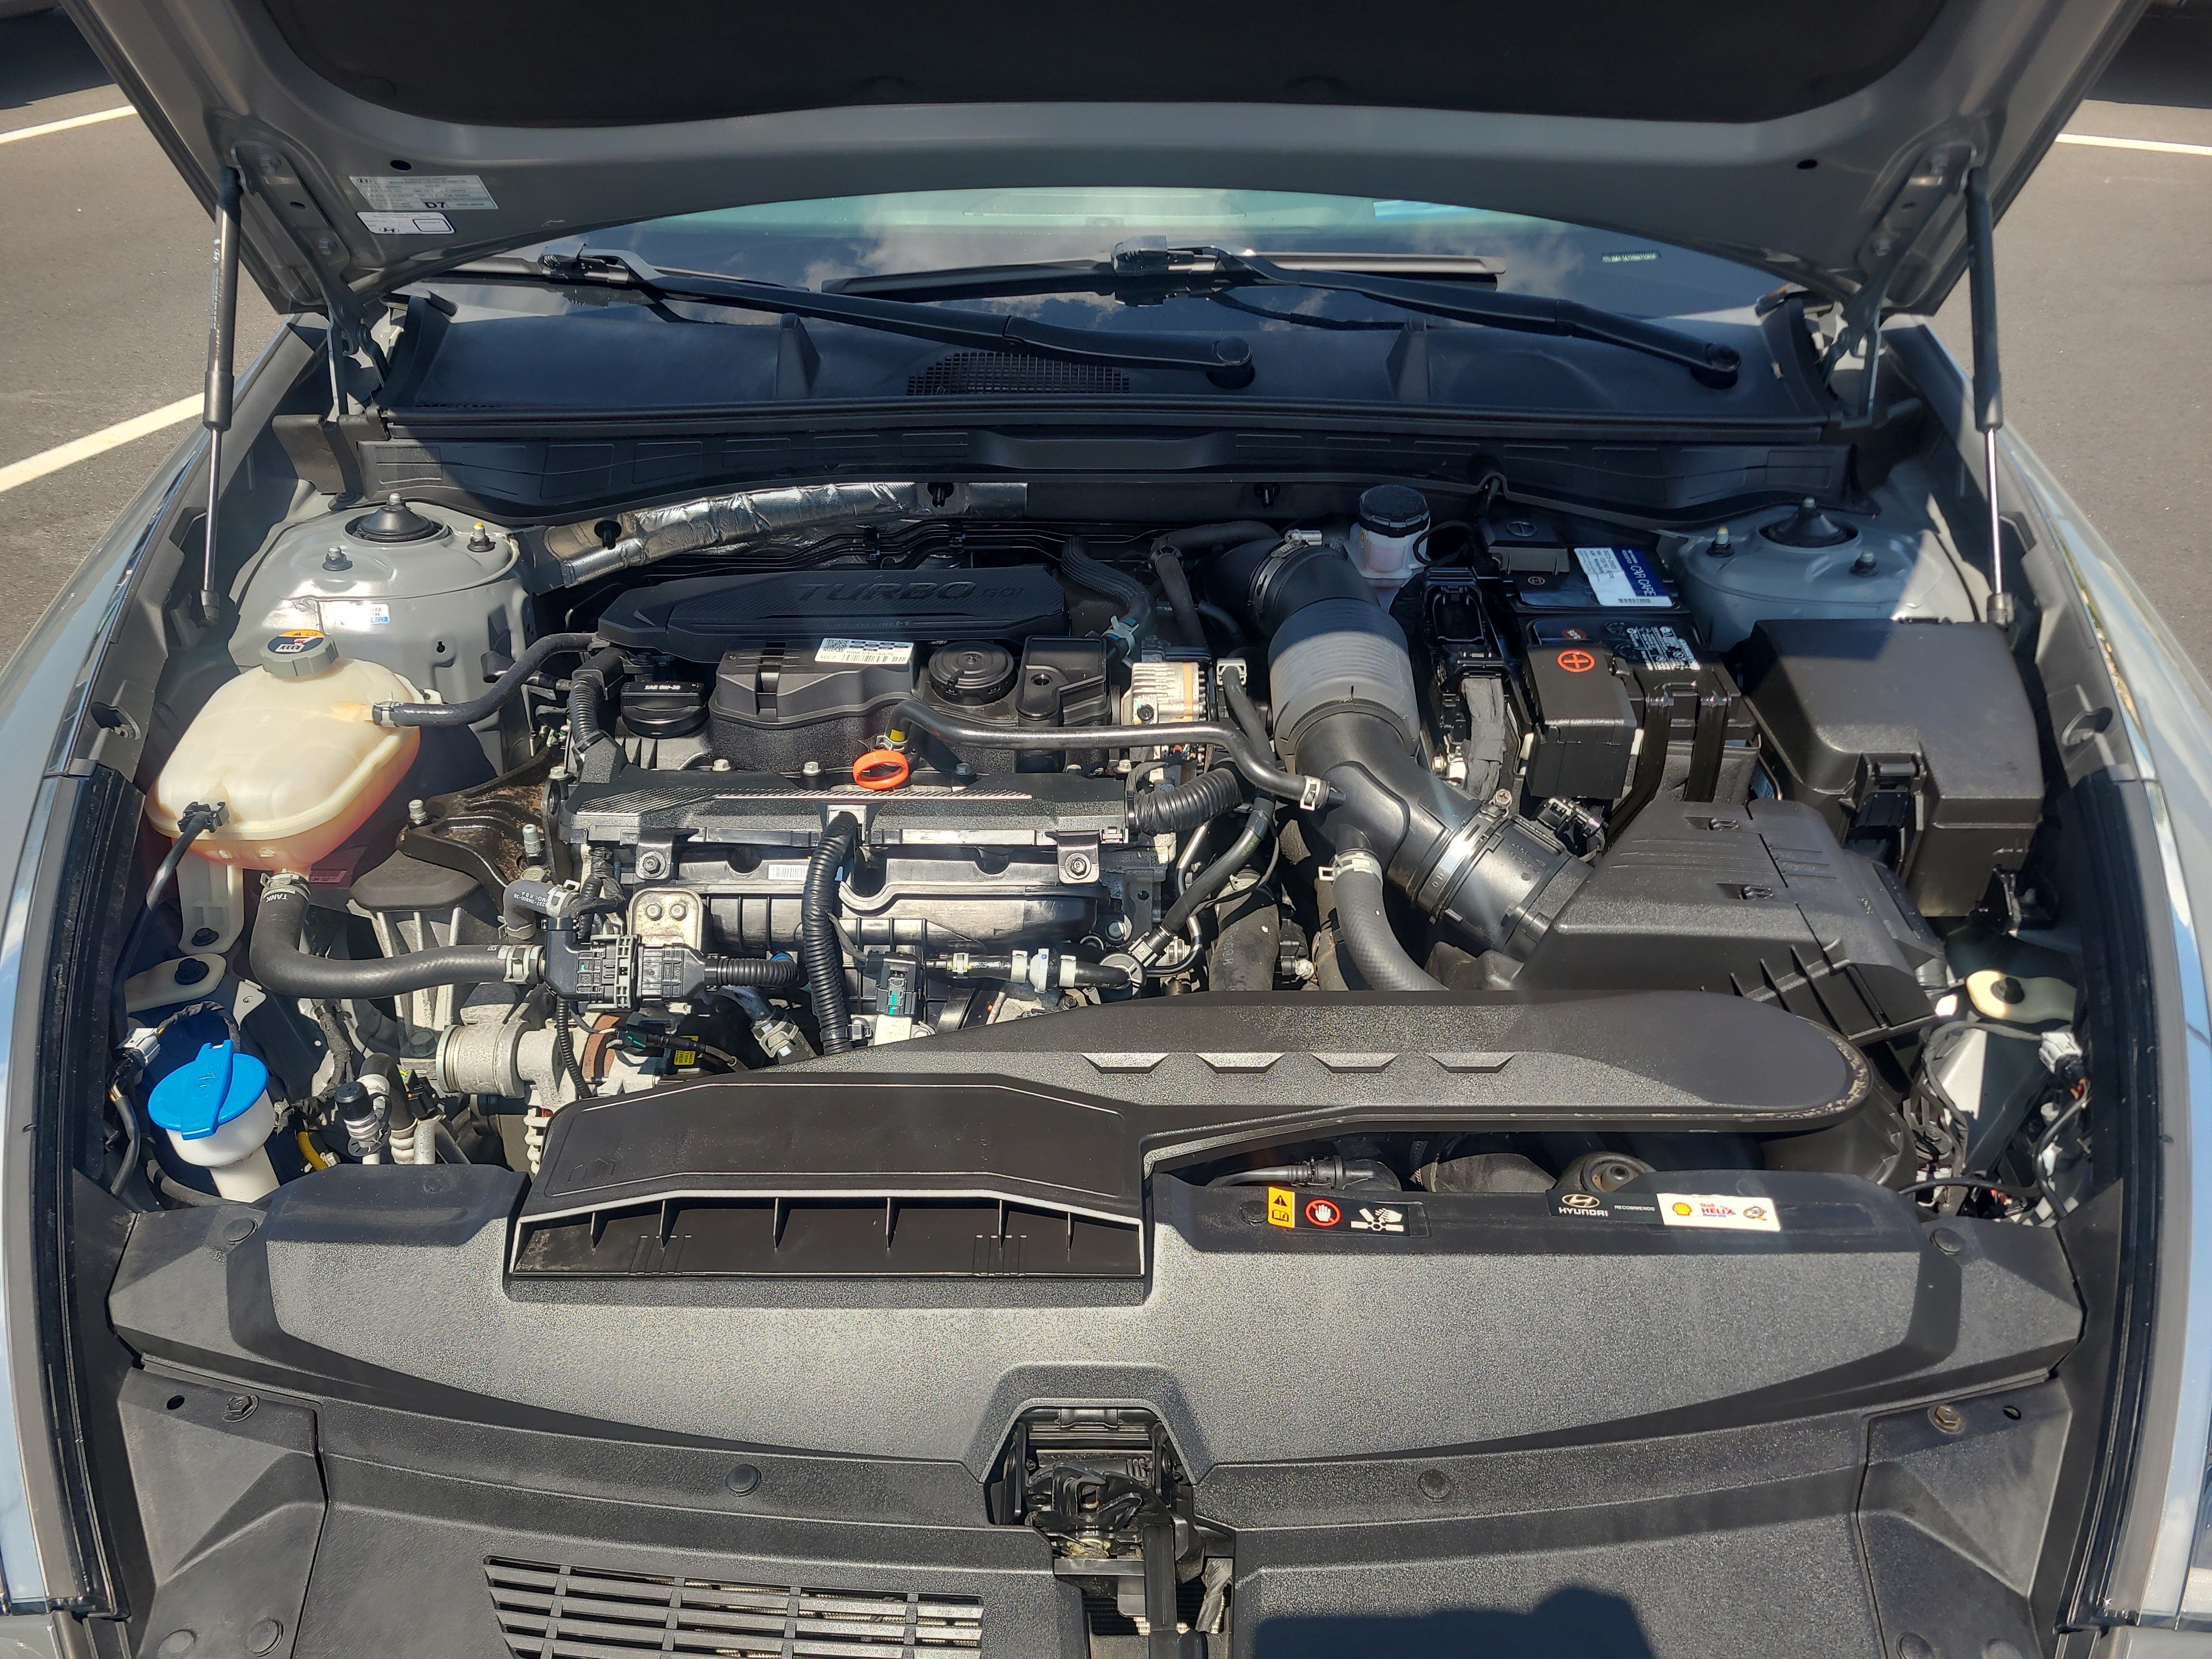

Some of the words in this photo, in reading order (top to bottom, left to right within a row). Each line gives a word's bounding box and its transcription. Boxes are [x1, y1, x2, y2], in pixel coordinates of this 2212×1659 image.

[1630, 565, 1646, 579] CAR
[1638, 579, 1657, 597] CARE
[798, 581, 977, 601] TURBO
[266, 893, 288, 902] TANK
[1558, 1207, 1609, 1217] HYUNDAI
[1701, 1206, 1736, 1215] HELIX
